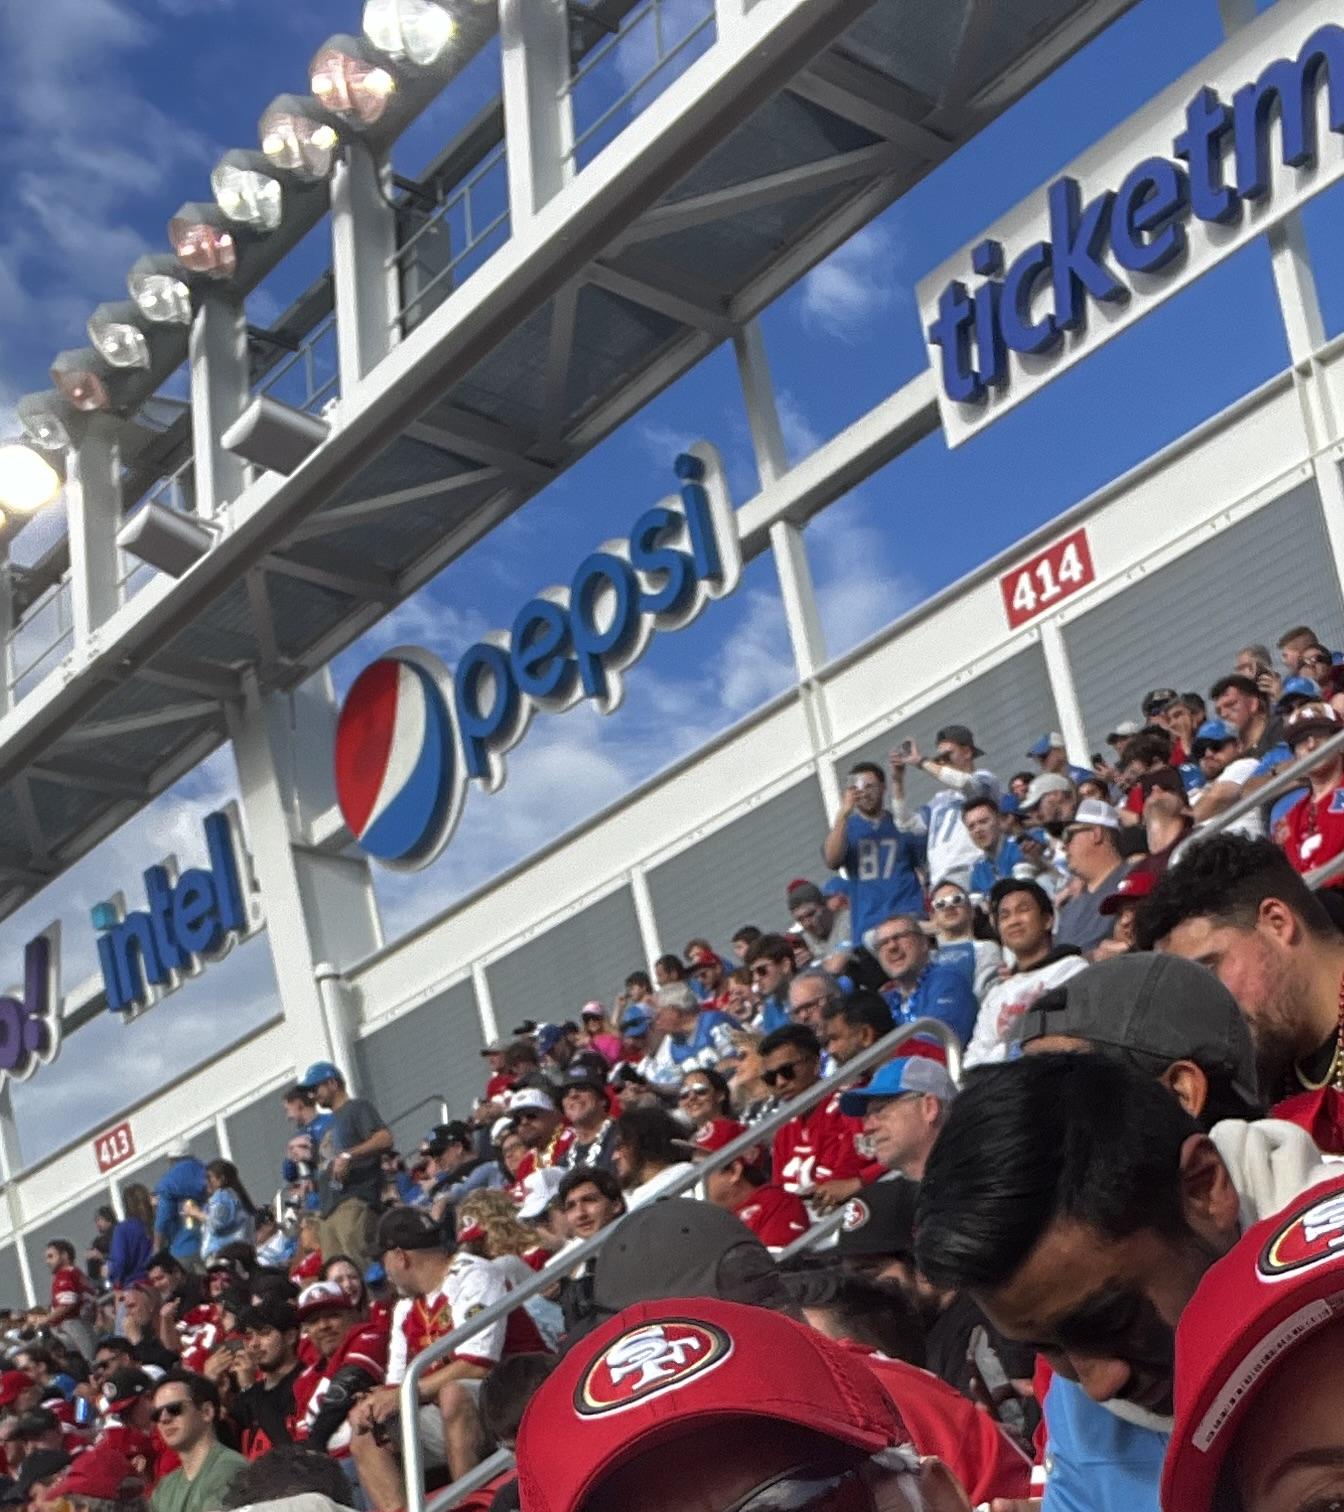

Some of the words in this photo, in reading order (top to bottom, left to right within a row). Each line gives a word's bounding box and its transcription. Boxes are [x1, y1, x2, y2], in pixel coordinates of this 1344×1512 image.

[1012, 542, 1084, 611] 414
[456, 452, 726, 779] pepsi
[857, 837, 898, 881] 87
[90, 811, 248, 1013] intel
[100, 1129, 130, 1165] 413
